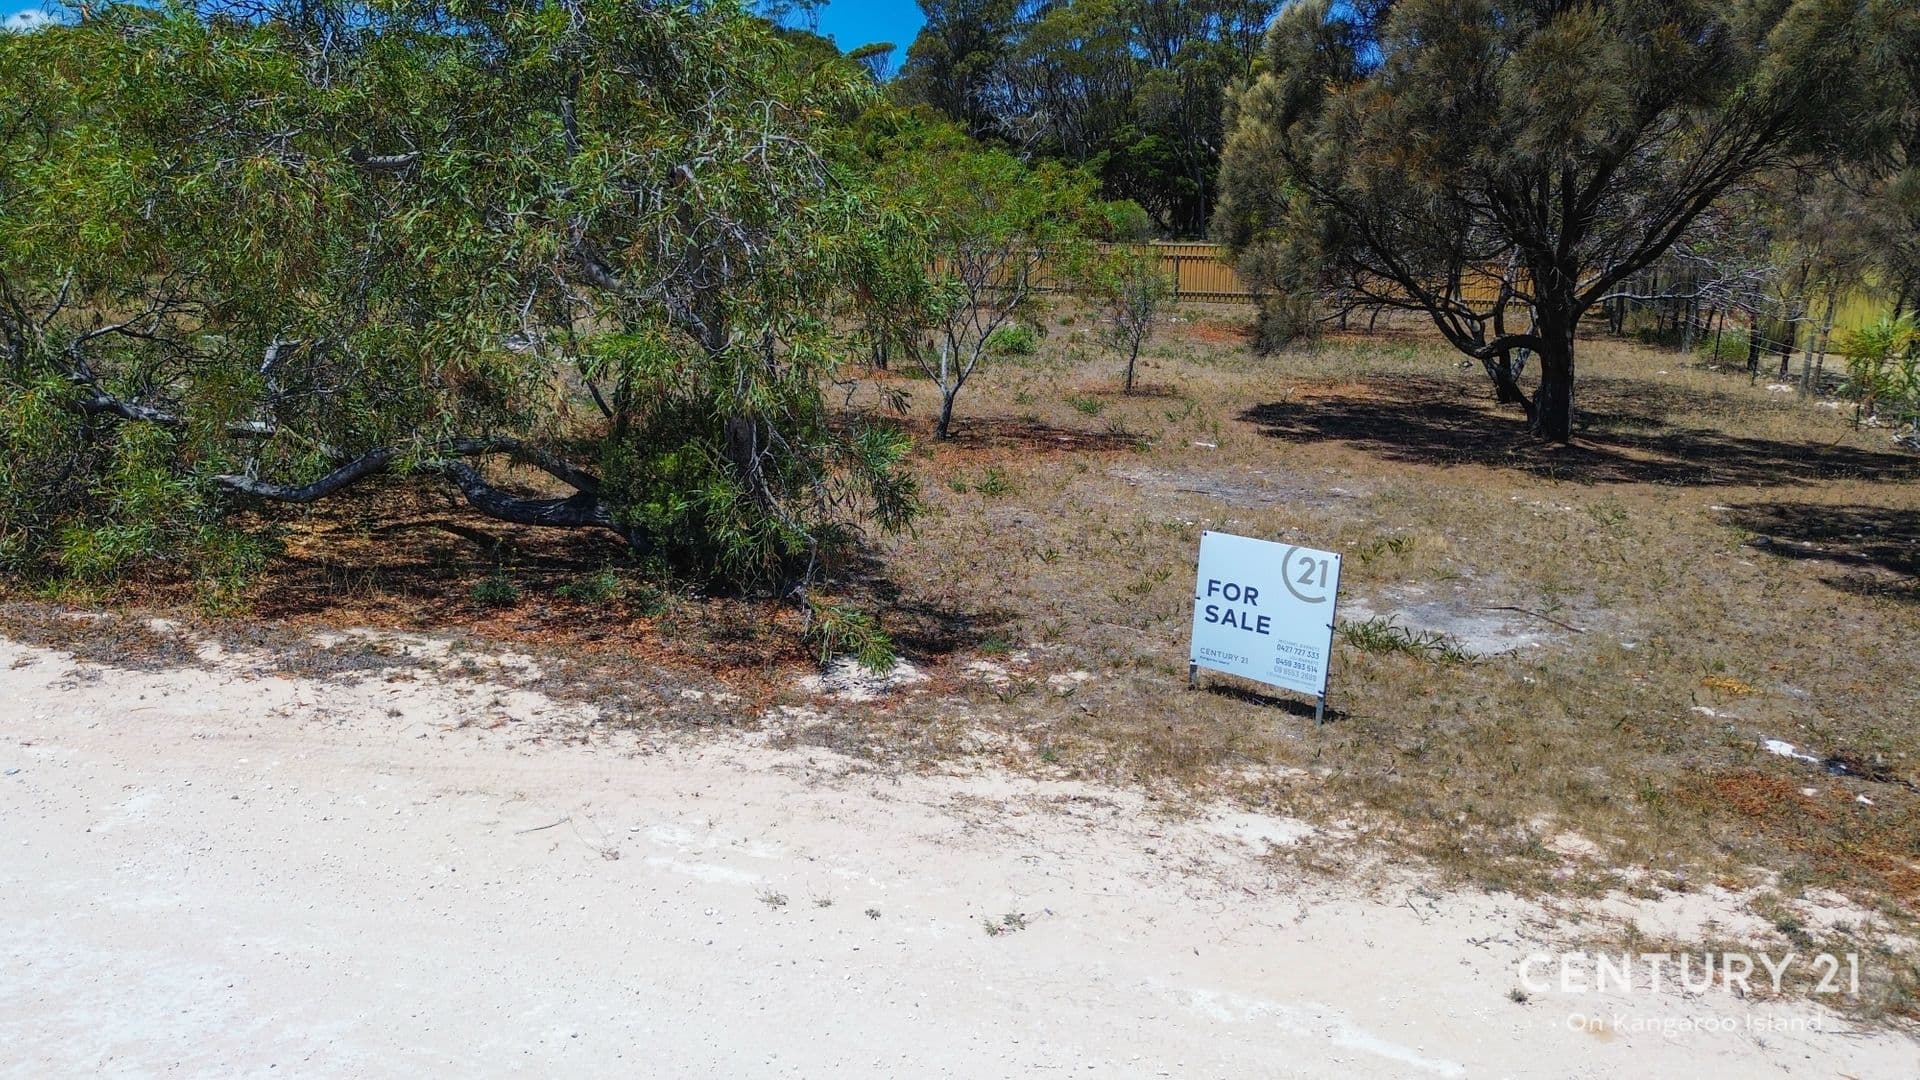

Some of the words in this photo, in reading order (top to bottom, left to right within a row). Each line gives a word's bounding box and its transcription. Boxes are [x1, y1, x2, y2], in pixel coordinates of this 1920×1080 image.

[1297, 557, 1329, 588] 21
[1207, 578, 1259, 606] FOR
[1205, 604, 1271, 635] SALE
[1200, 647, 1239, 662] CENTURY
[1241, 656, 1249, 665] 21
[1276, 643, 1293, 652] 0427
[1294, 647, 1305, 656] 727
[1307, 651, 1320, 659] 333
